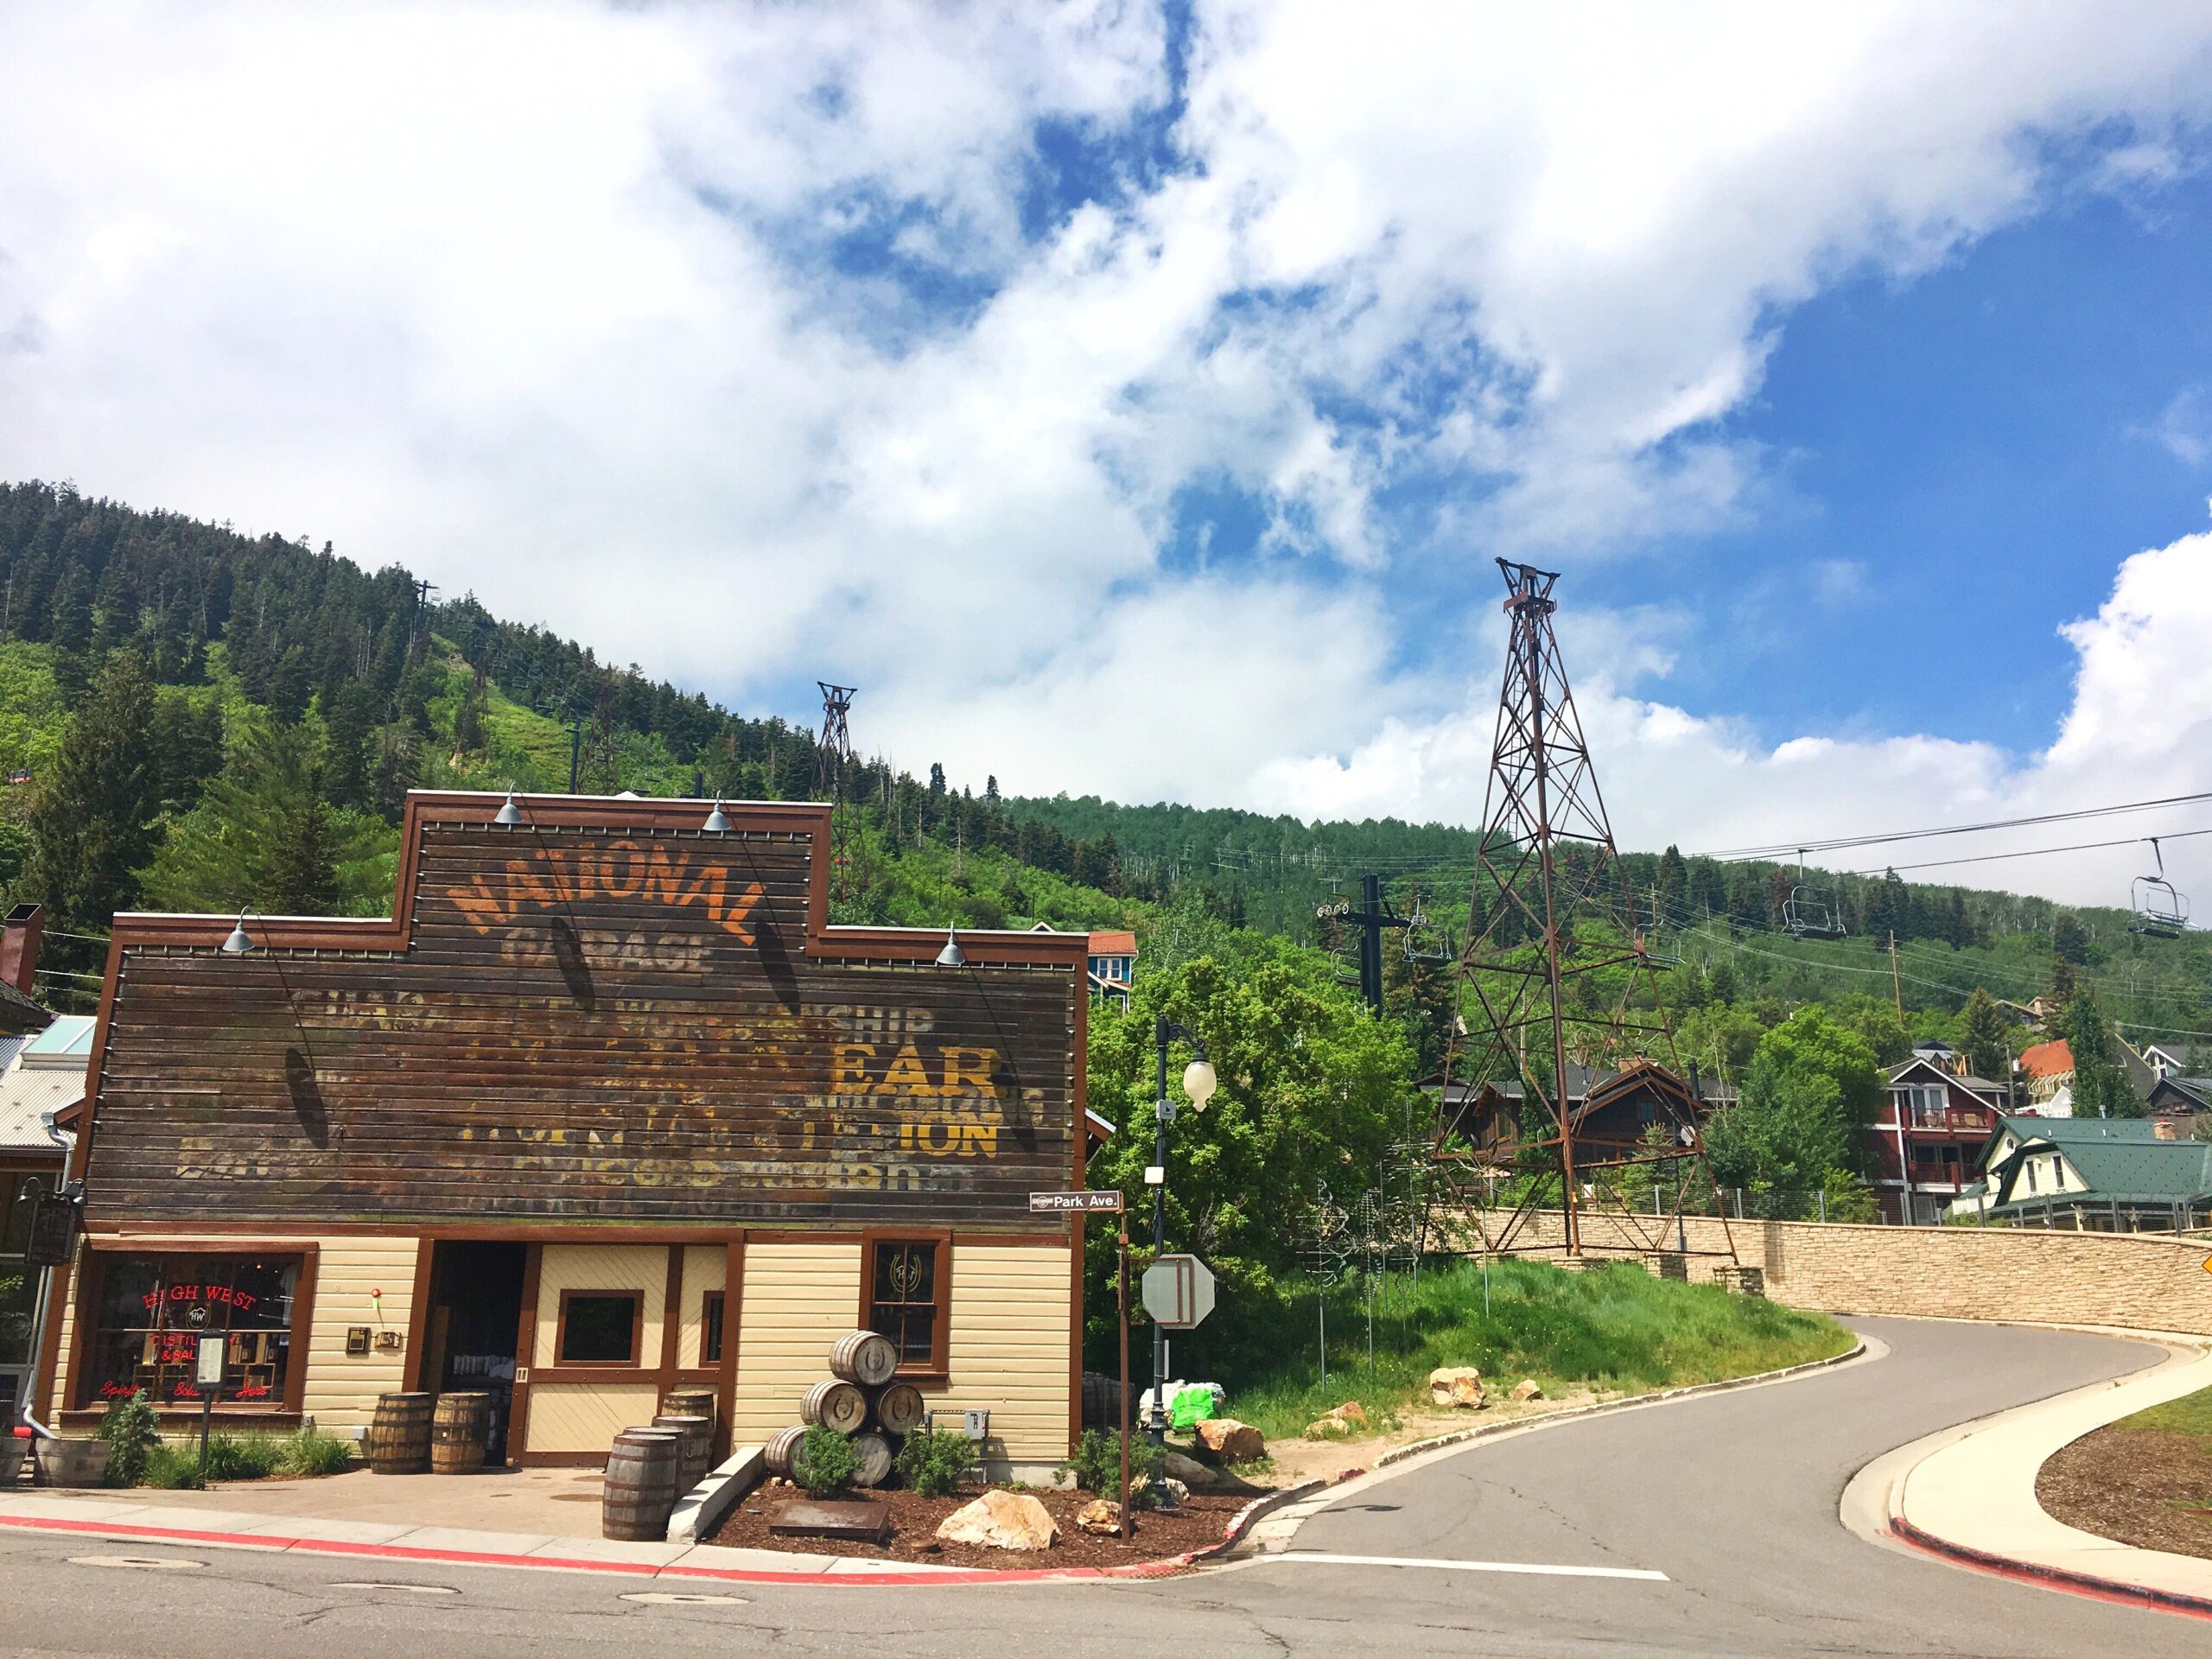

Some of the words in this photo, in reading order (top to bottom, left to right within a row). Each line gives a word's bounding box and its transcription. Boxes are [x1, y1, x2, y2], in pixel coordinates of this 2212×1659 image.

[445, 840, 767, 947] NATIONAL
[1054, 1196, 1084, 1208] Park
[1090, 1195, 1118, 1206] Ave.
[143, 1285, 200, 1309] HIGH
[206, 1285, 256, 1311] WEST
